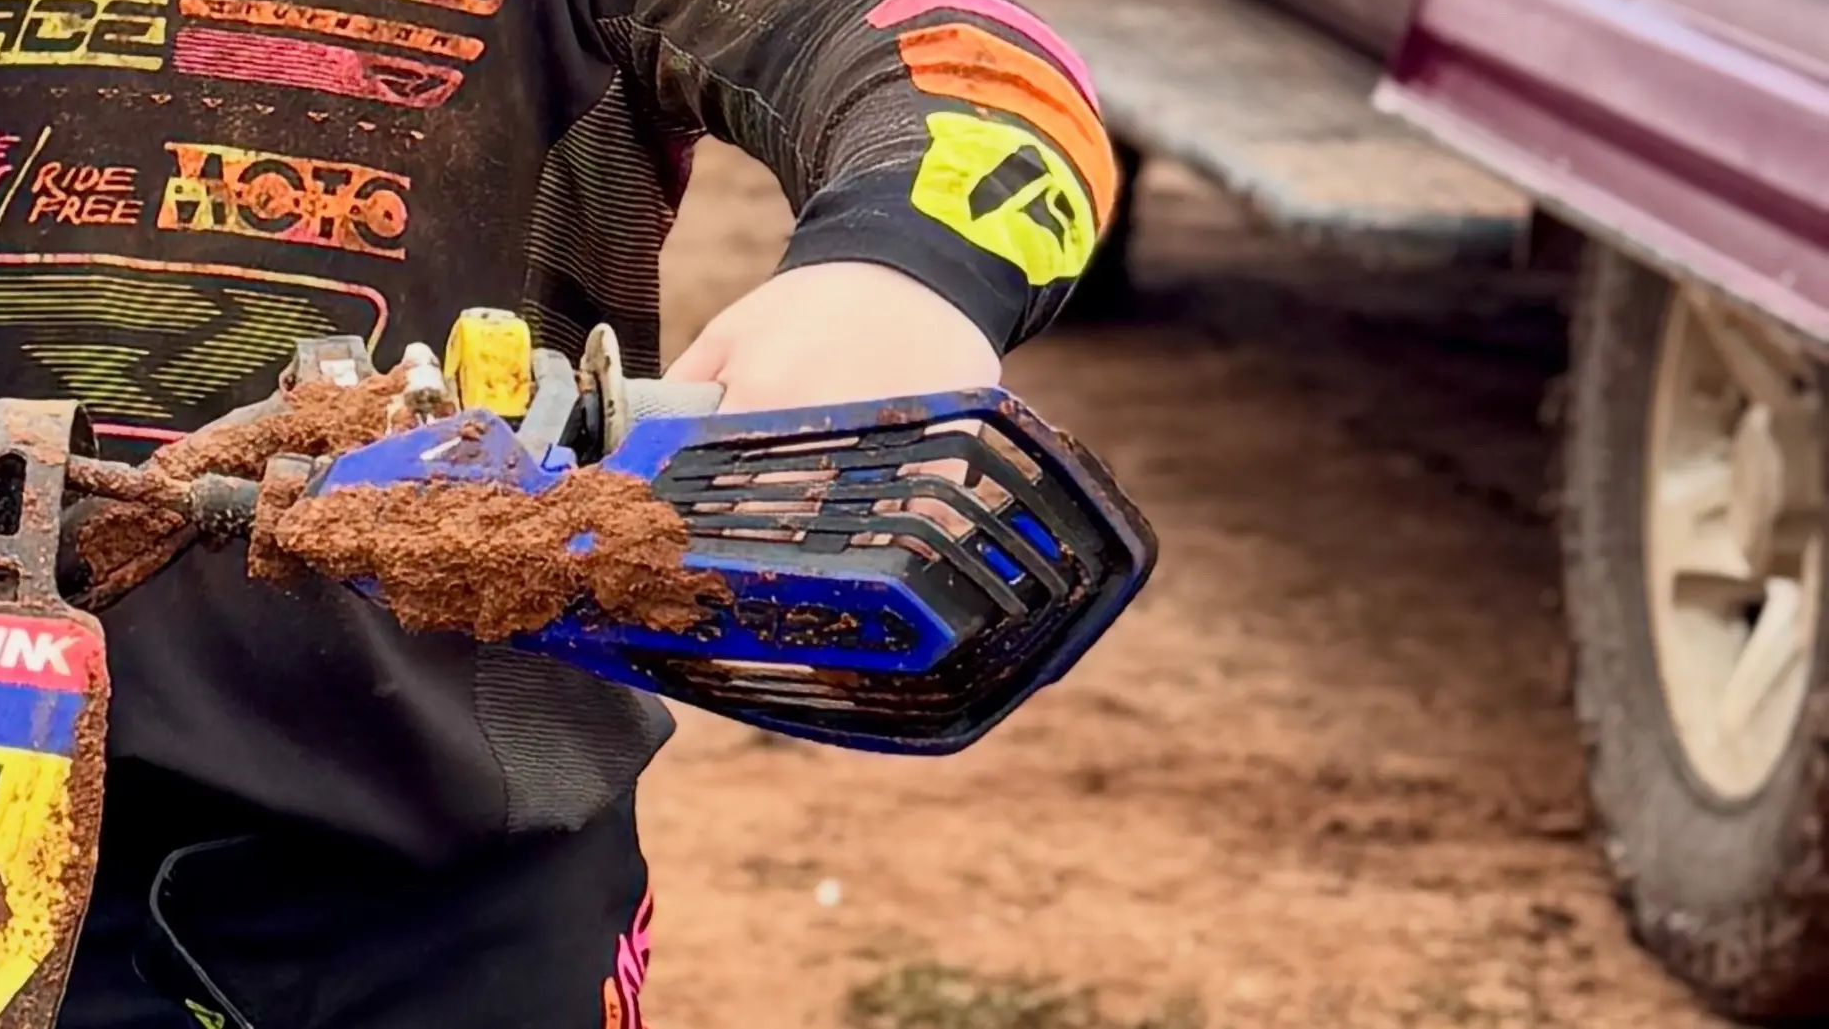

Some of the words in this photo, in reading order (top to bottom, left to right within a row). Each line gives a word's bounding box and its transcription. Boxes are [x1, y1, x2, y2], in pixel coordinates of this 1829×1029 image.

[31, 161, 139, 197] RIDE
[28, 195, 144, 225] FREE
[162, 148, 411, 256] MOTO
